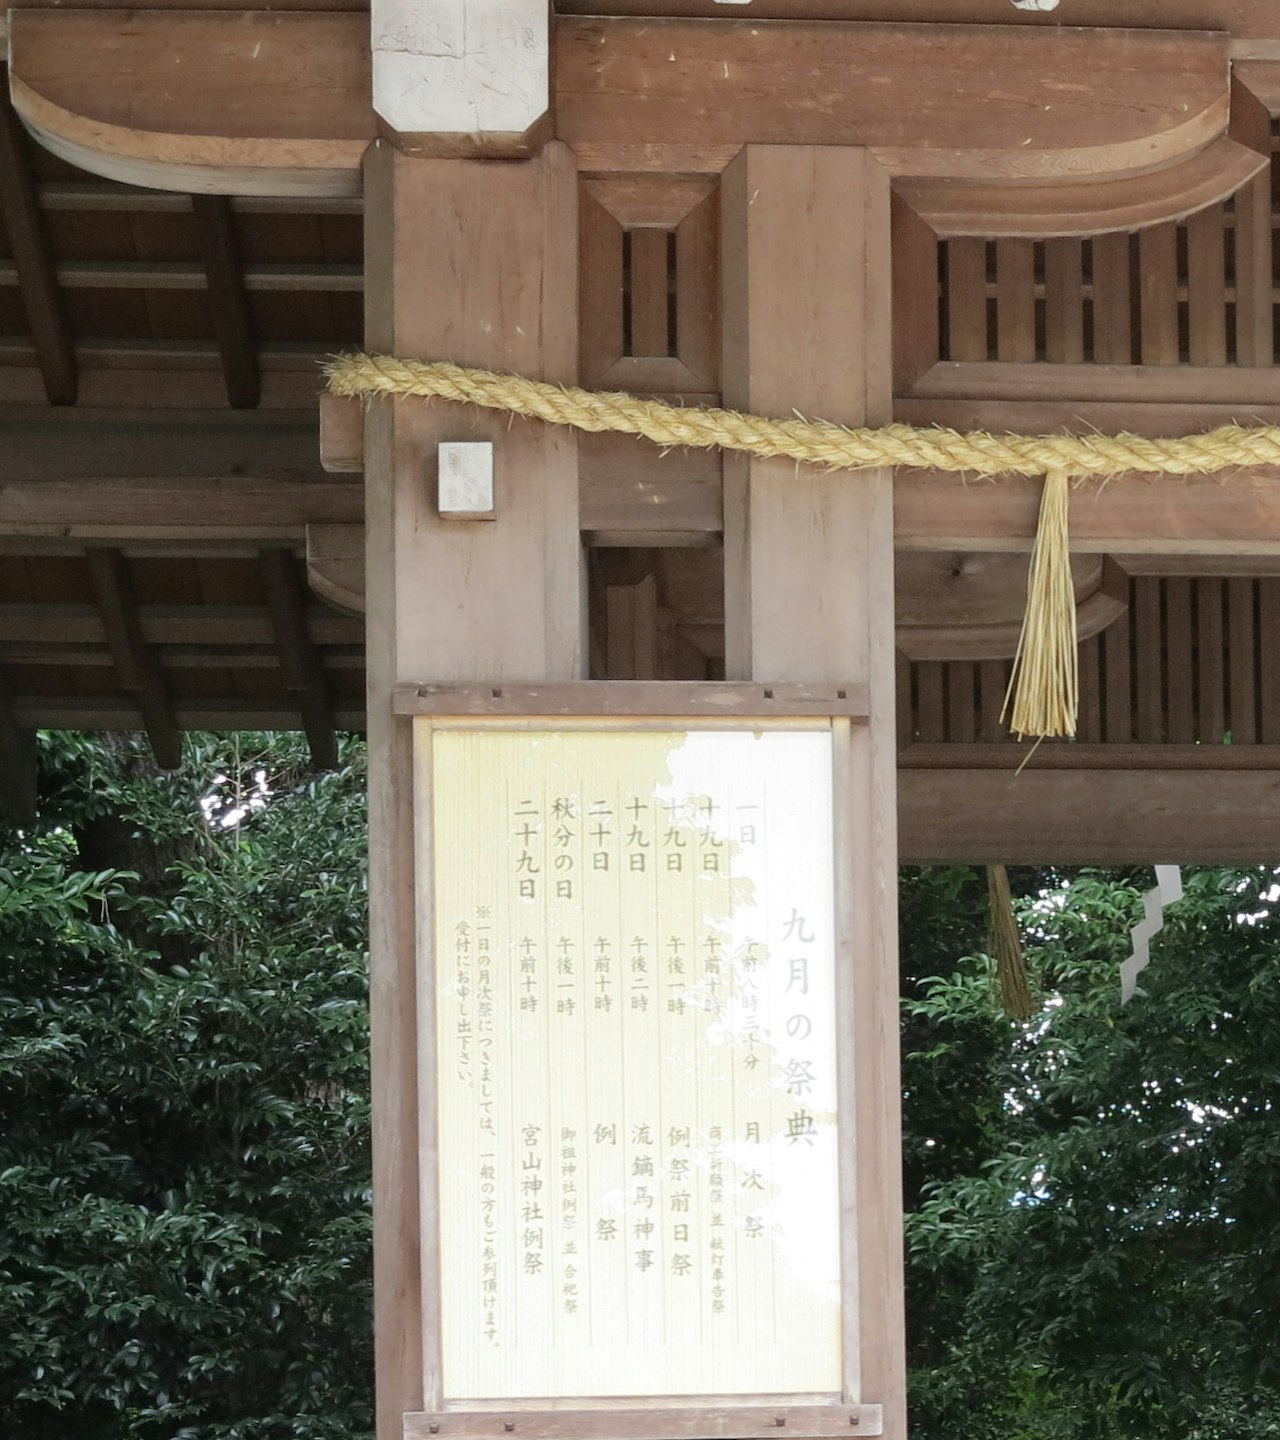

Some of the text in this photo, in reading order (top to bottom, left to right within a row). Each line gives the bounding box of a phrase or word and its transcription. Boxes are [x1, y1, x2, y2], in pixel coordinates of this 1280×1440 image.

[551, 797, 577, 900] 秋分の日
[588, 799, 613, 872] 二十日
[699, 795, 724, 873] 十九日
[735, 802, 760, 846] 一日
[453, 919, 476, 1089] 受付にお申し出下さい。
[556, 935, 576, 1017] 午後一時
[593, 935, 613, 1013] 午前十時
[701, 935, 724, 1015] 午前十時
[514, 799, 545, 1276] 二十九日 午前十時 宮山神社例祭
[624, 795, 656, 1274] 十九日 午後二時 流鏑馬神事
[662, 795, 694, 1277] 十九日 午後一時 例祭前日祭
[781, 906, 820, 1148] 九月の祭典
[559, 1126, 577, 1231] 御祖神社例祭
[740, 1120, 766, 1240] 月次祭
[562, 1262, 580, 1315] 合祀祭
